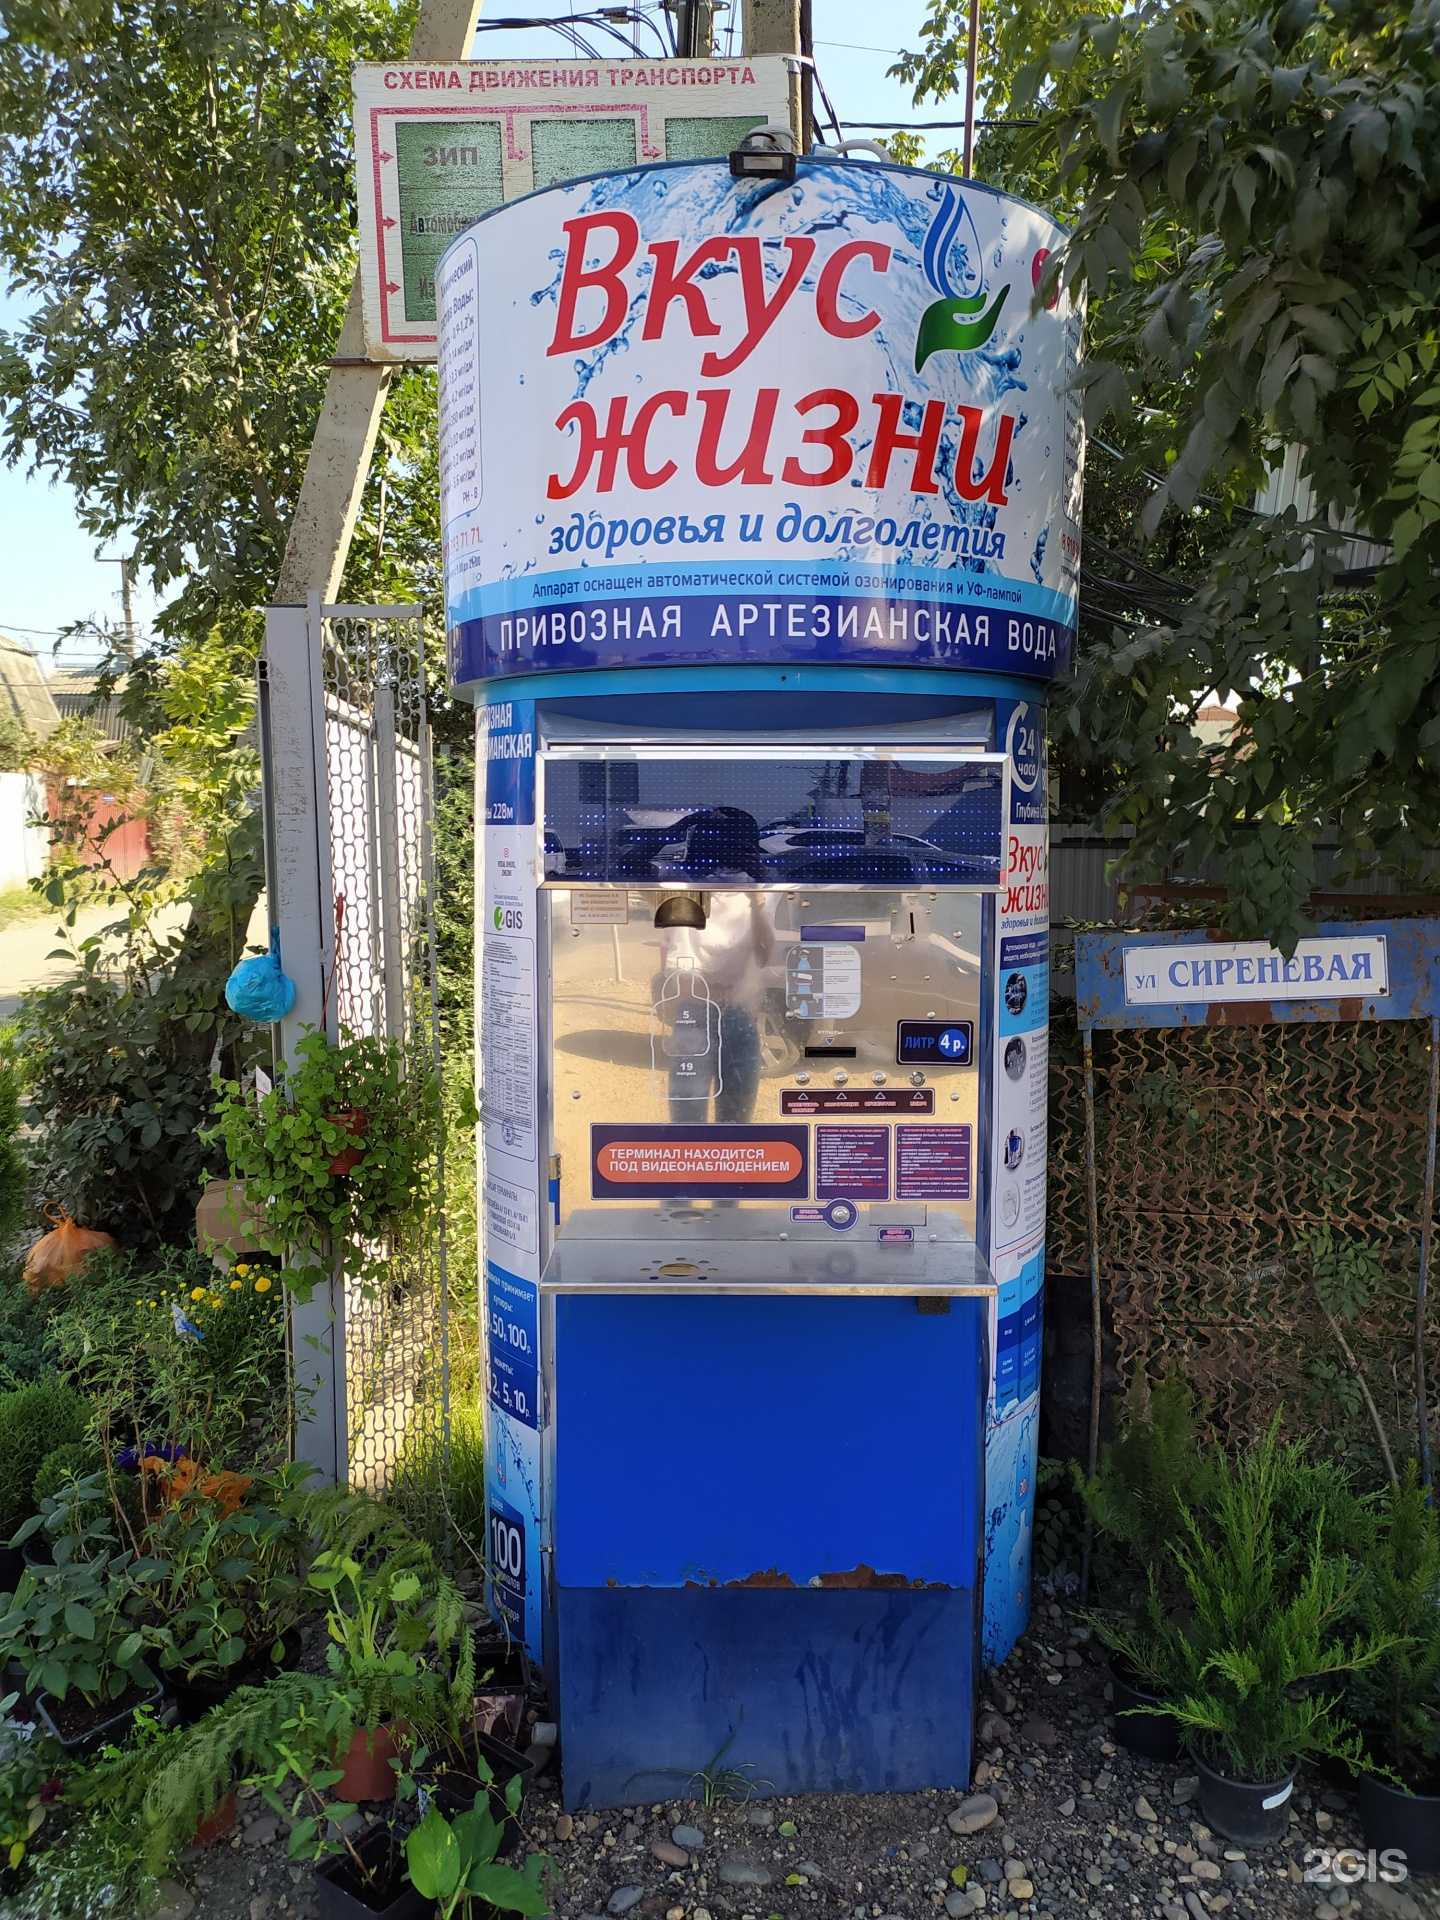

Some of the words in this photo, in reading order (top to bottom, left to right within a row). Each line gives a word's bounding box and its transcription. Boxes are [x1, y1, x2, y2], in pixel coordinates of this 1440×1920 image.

[384, 70, 461, 90] СХЕМА
[469, 69, 598, 92] ДВИЖЕНИЯ
[610, 67, 756, 87] ТРАНСПОРТА
[424, 147, 478, 166] ЗИП
[547, 211, 891, 378] Вкус
[547, 387, 1015, 506] жизни
[549, 513, 726, 558] здоровья
[740, 514, 764, 542] и
[776, 503, 1005, 560] долголетия
[532, 580, 580, 599] Аппарат
[583, 576, 643, 592] оснащен
[647, 570, 773, 588] автоматической
[778, 569, 850, 587] системой
[855, 575, 952, 594] озонирования
[957, 585, 964, 596] и
[967, 581, 1022, 605] УФ-лампой
[500, 604, 682, 652] ПРИВОЗНАЯ
[710, 603, 989, 647] АРТЕЗИАНСКАЯ
[1008, 619, 1056, 661] ВОДА
[487, 733, 532, 760] ИАНСКАЯ
[1018, 727, 1035, 757] 24
[493, 803, 513, 820] 228м
[1001, 883, 1048, 914] жизн
[1135, 974, 1157, 990] ул
[1168, 952, 1373, 987] СИРЕНЕВАЯ
[682, 1011, 690, 1019] 5
[905, 1036, 935, 1049] ЛИТР
[680, 1063, 694, 1071] 19
[609, 1148, 682, 1160] ТЕРМИНАЛ
[684, 1148, 764, 1161] НАХОДИТСЯ
[609, 1161, 638, 1173] ПОД
[641, 1161, 790, 1173] ВИДЕОНАБЛЮДЕНИЕМ
[492, 1517, 521, 1577] 100
